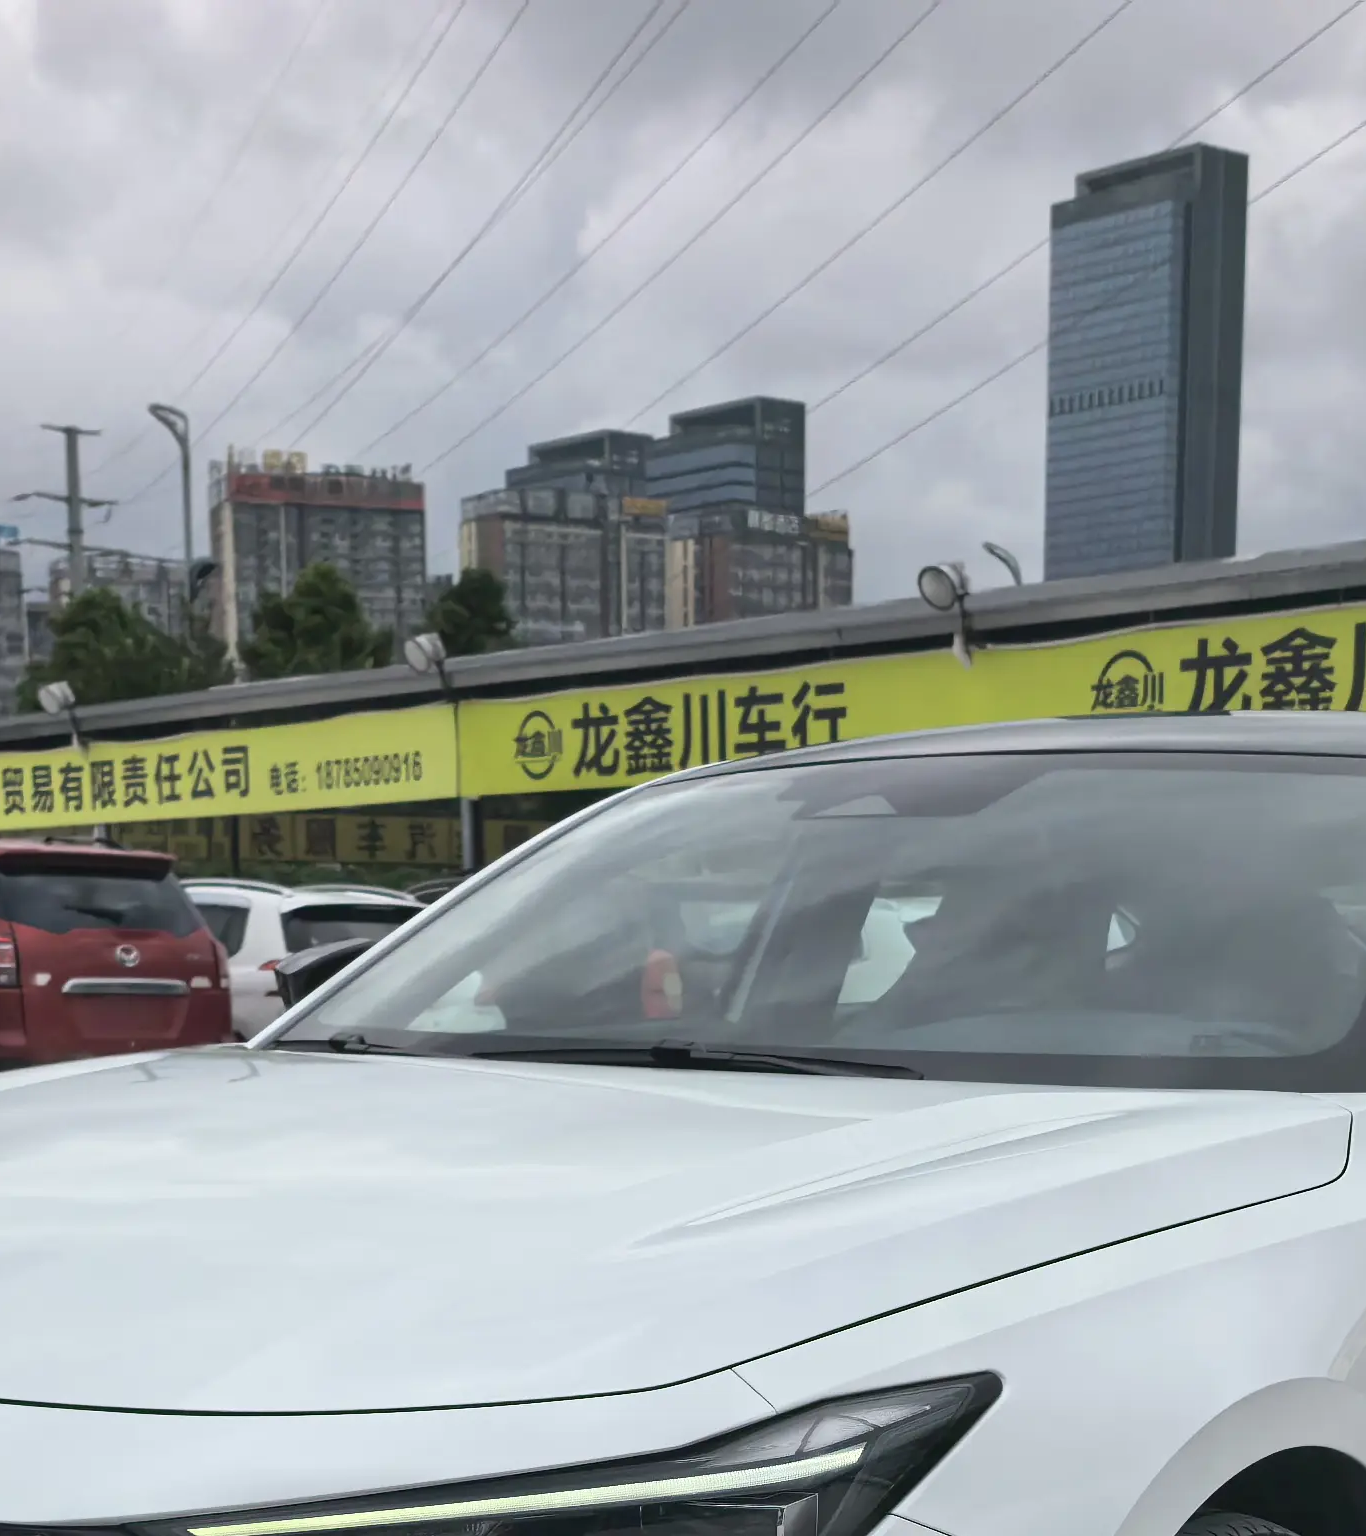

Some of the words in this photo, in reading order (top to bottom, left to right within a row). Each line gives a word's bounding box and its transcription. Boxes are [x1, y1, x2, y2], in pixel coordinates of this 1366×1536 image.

[1091, 672, 1164, 711] 龙鑫川
[570, 681, 847, 777] 龙鑫川车行
